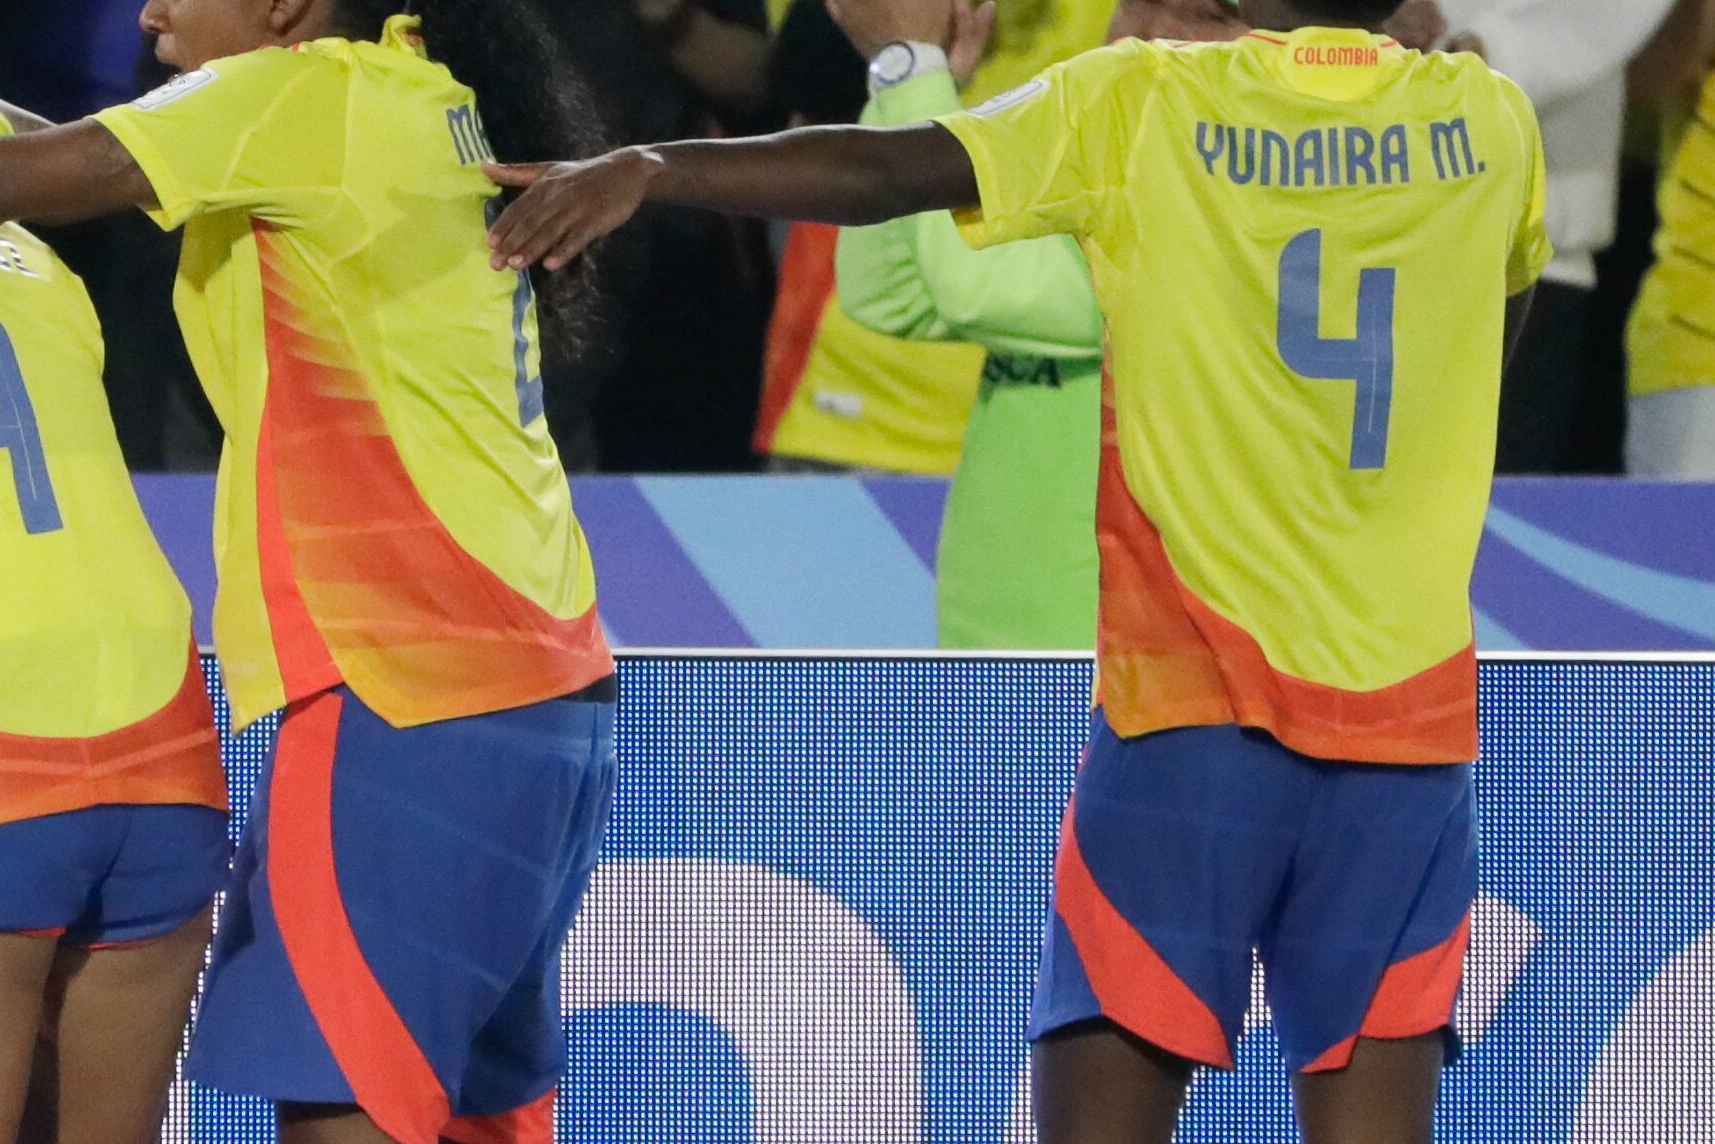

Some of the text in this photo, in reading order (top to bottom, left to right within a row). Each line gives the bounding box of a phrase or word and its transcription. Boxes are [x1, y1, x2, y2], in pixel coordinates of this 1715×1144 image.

[1293, 46, 1378, 66] COLOMBIA
[1195, 116, 1486, 187] YUNAIRA M.
[1276, 227, 1396, 470] 4
